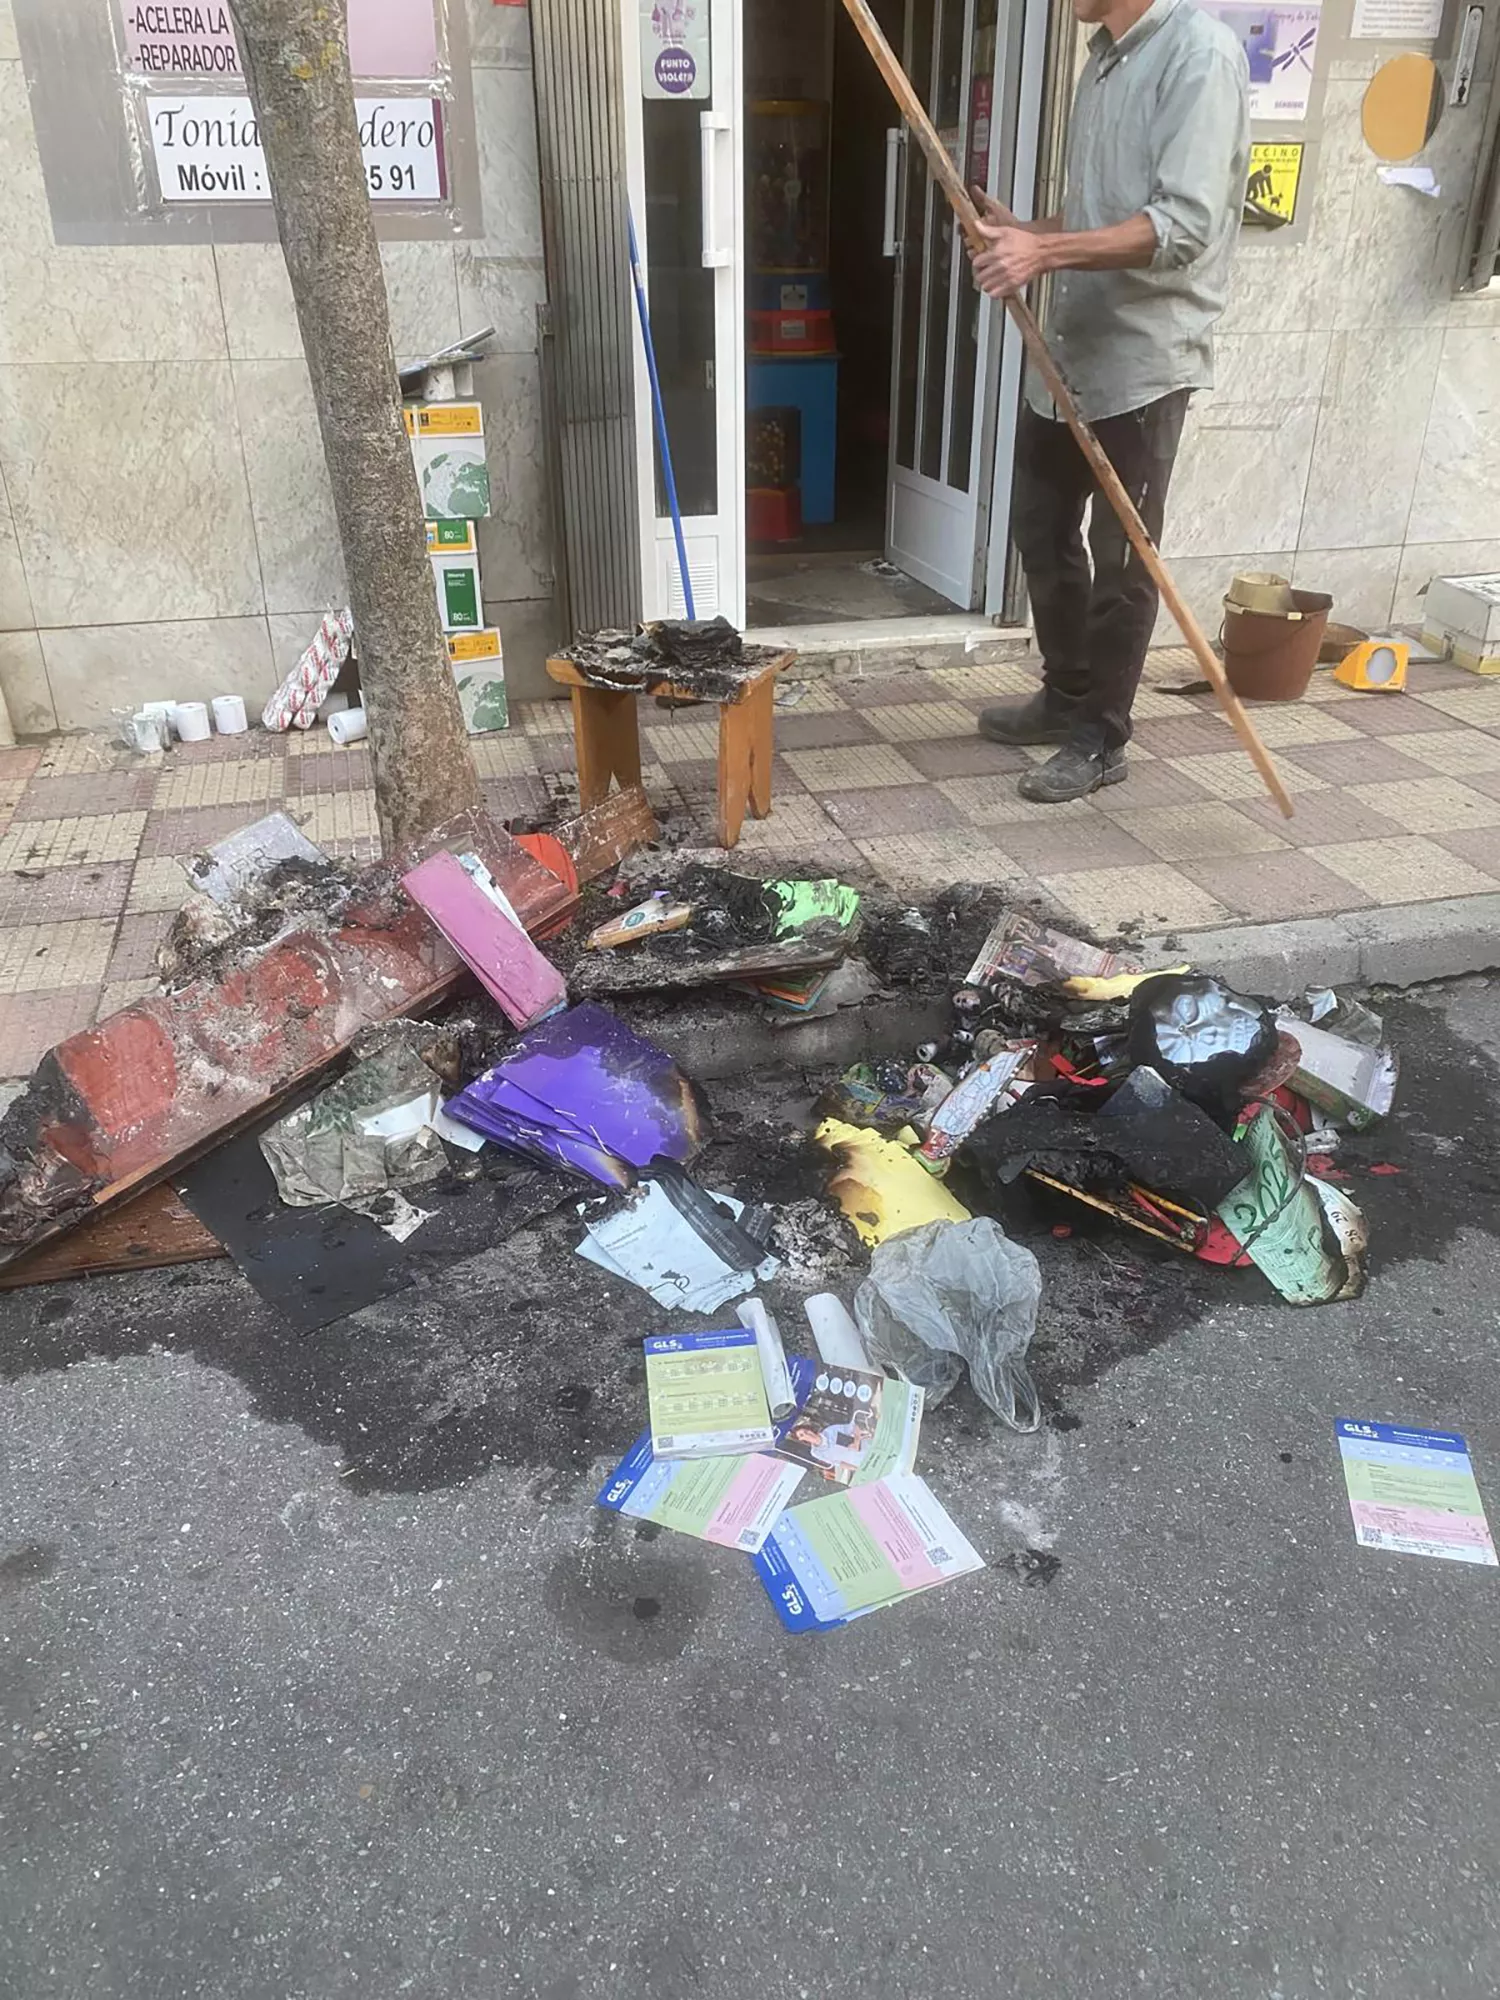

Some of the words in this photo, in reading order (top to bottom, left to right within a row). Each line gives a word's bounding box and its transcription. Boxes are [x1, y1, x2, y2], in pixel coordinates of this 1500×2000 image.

[129, 6, 206, 34] -ACELERA
[207, 7, 230, 34] LA
[135, 44, 238, 71] -REPARADOR
[660, 58, 690, 70] PUNTO
[359, 105, 434, 148] dero
[1253, 147, 1299, 157] ECINO
[177, 163, 246, 191] Móvil
[364, 164, 383, 191] 5
[389, 164, 416, 191] 91
[653, 1339, 677, 1349] GLS
[1343, 1423, 1372, 1434] GLS
[606, 1480, 626, 1502] GLS
[781, 1589, 803, 1615] GLS
